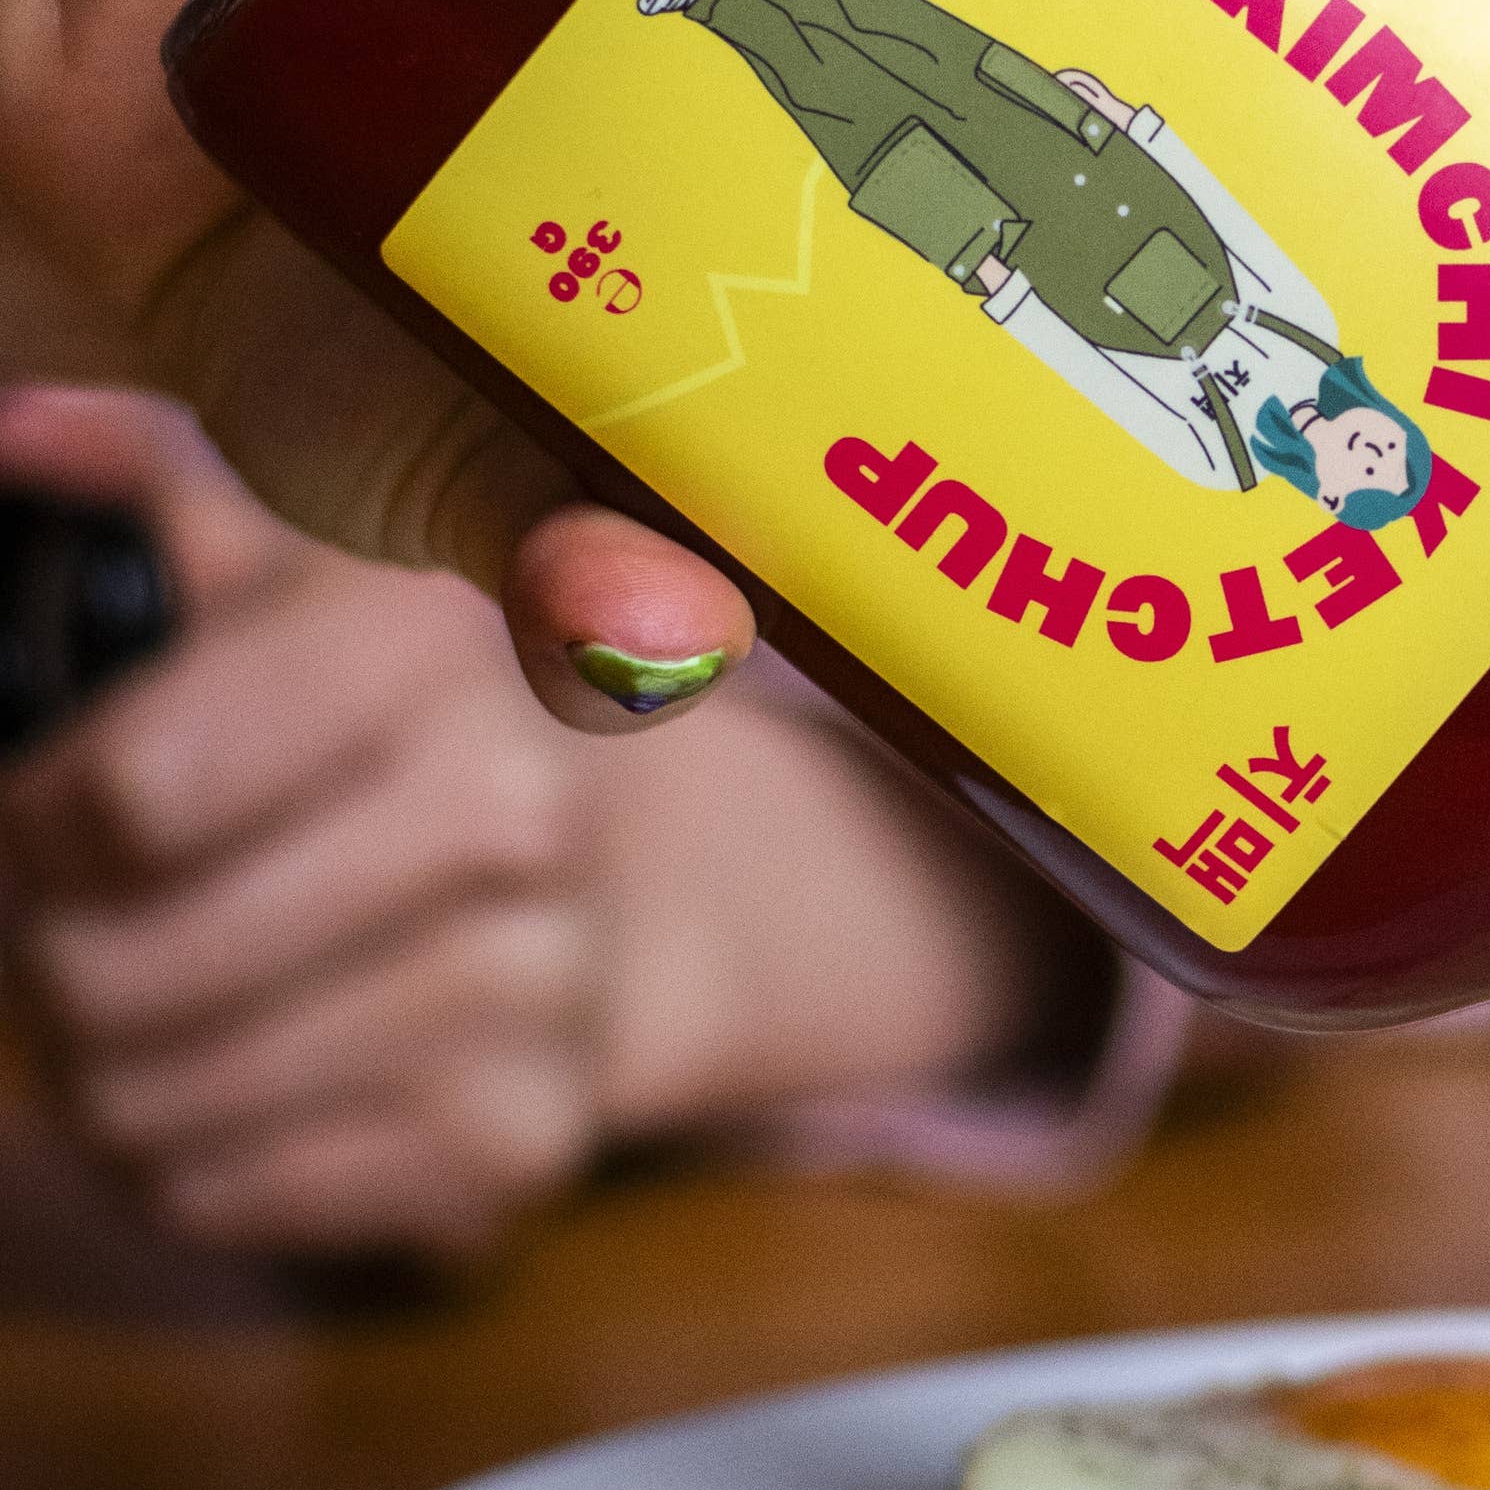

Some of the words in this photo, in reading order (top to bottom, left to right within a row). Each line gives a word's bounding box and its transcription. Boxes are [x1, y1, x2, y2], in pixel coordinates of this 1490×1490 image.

[530, 220, 567, 255] G
[548, 220, 622, 303] 390
[823, 436, 1482, 664] KETCHUP
[1152, 725, 1332, 906] 치맥
